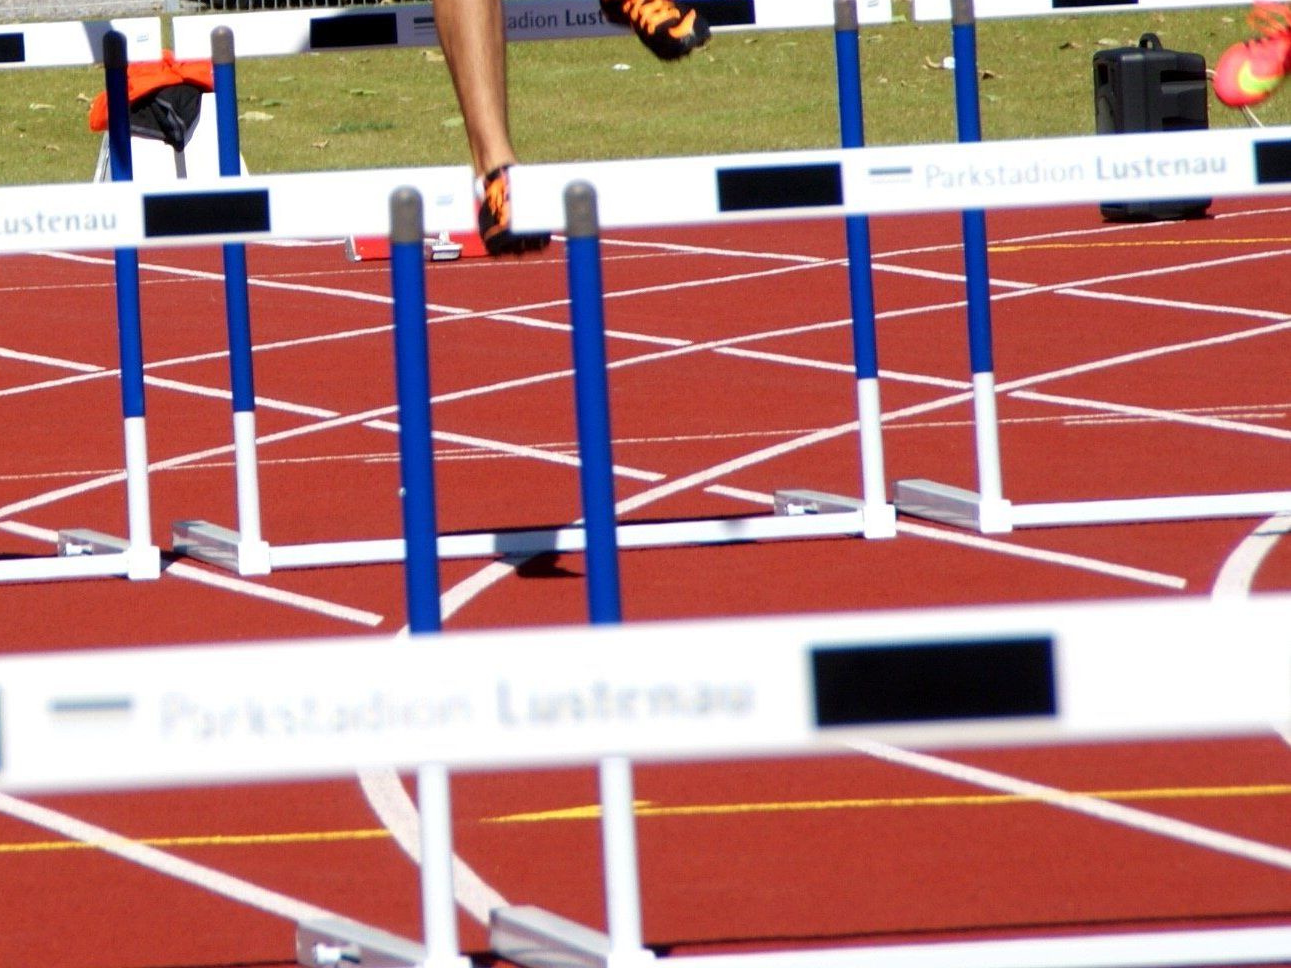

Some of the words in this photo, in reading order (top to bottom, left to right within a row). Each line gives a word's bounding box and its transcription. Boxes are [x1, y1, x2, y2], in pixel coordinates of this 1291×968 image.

[925, 161, 1085, 189] Parkstadion
[1094, 154, 1228, 181] Lustenau
[159, 687, 472, 741] Parkstadion
[495, 675, 758, 729] Lustenau
